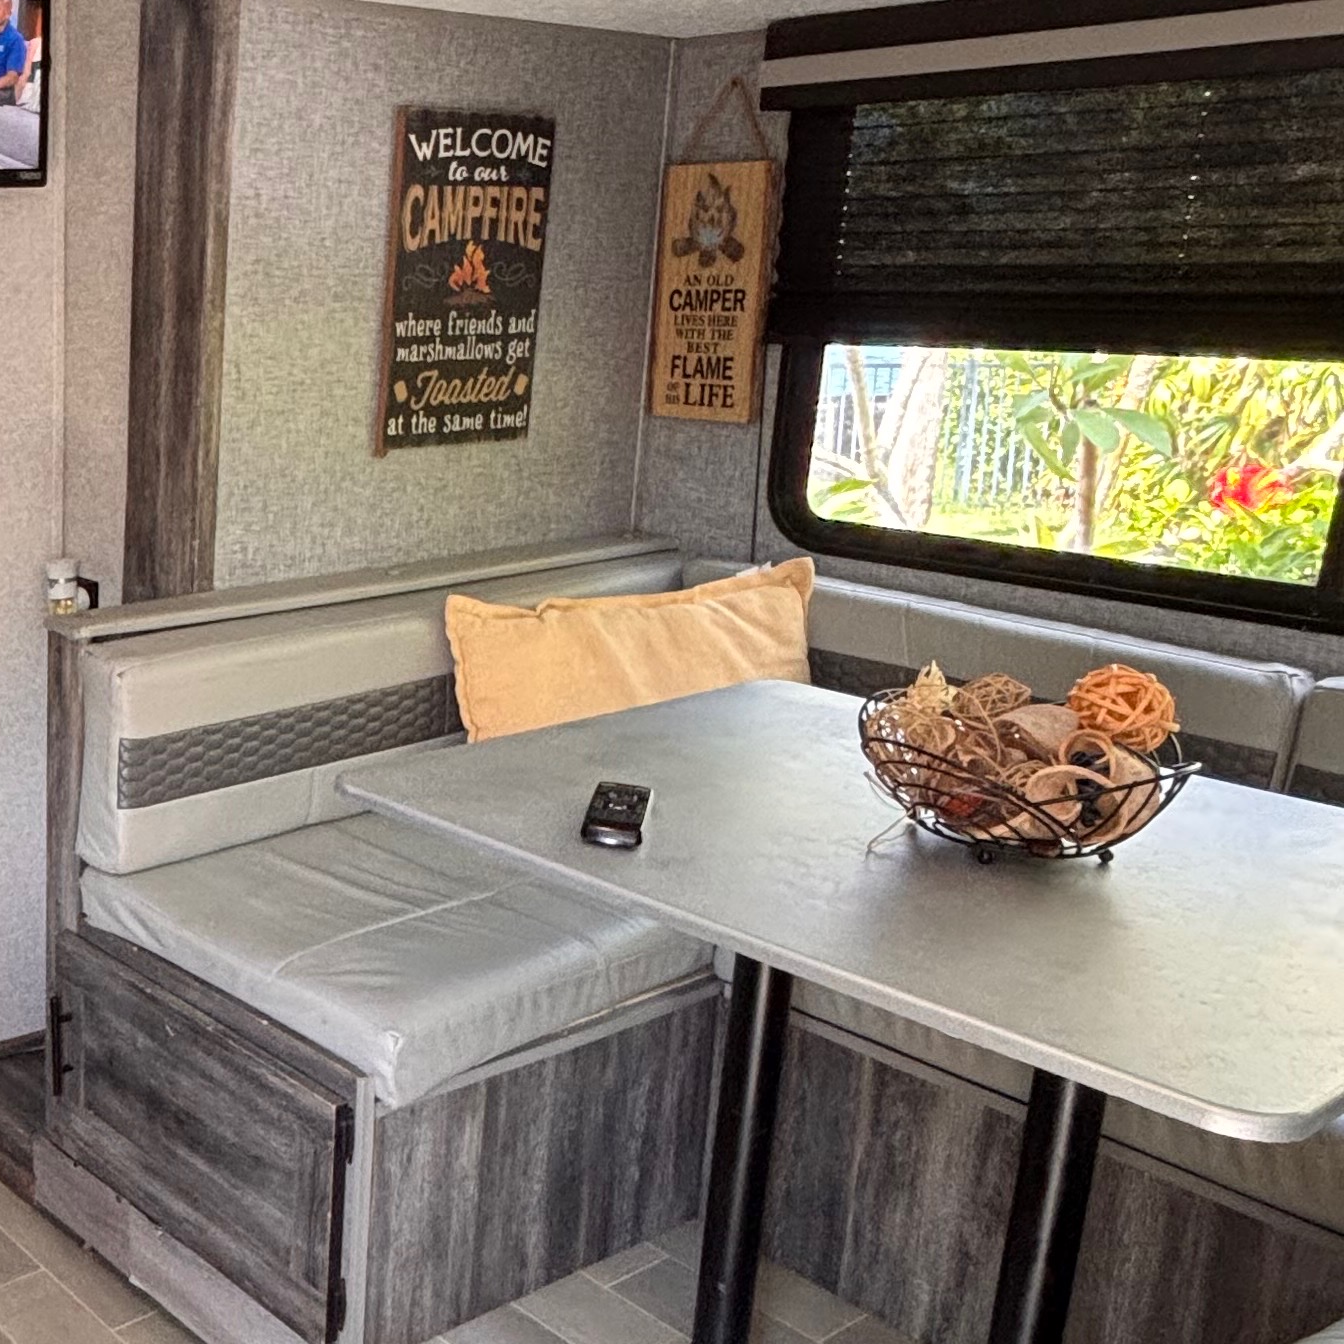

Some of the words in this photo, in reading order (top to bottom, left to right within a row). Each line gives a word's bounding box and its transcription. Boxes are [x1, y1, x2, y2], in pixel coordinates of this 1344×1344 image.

[408, 127, 552, 168] WELCOME
[448, 161, 469, 181] to
[474, 167, 510, 182] our
[402, 184, 546, 253] CAMPFIRE
[684, 274, 702, 286] AN
[707, 274, 734, 286] OLD
[669, 289, 746, 312] CAMPER
[395, 312, 442, 338] where
[448, 310, 504, 336] friends
[508, 309, 536, 334] and
[674, 314, 704, 328] LIVES
[708, 314, 738, 328] HERE
[675, 328, 705, 341] WITH
[710, 328, 734, 341] THE
[395, 338, 503, 363] marshmallows
[506, 341, 531, 365] get
[686, 342, 719, 355] BEST
[670, 355, 734, 381] FLAME
[410, 366, 516, 411] Toasted
[683, 382, 735, 409] LIFE
[387, 415, 405, 436] at
[411, 412, 436, 435] the
[442, 413, 483, 432] same
[489, 405, 528, 429] time!
